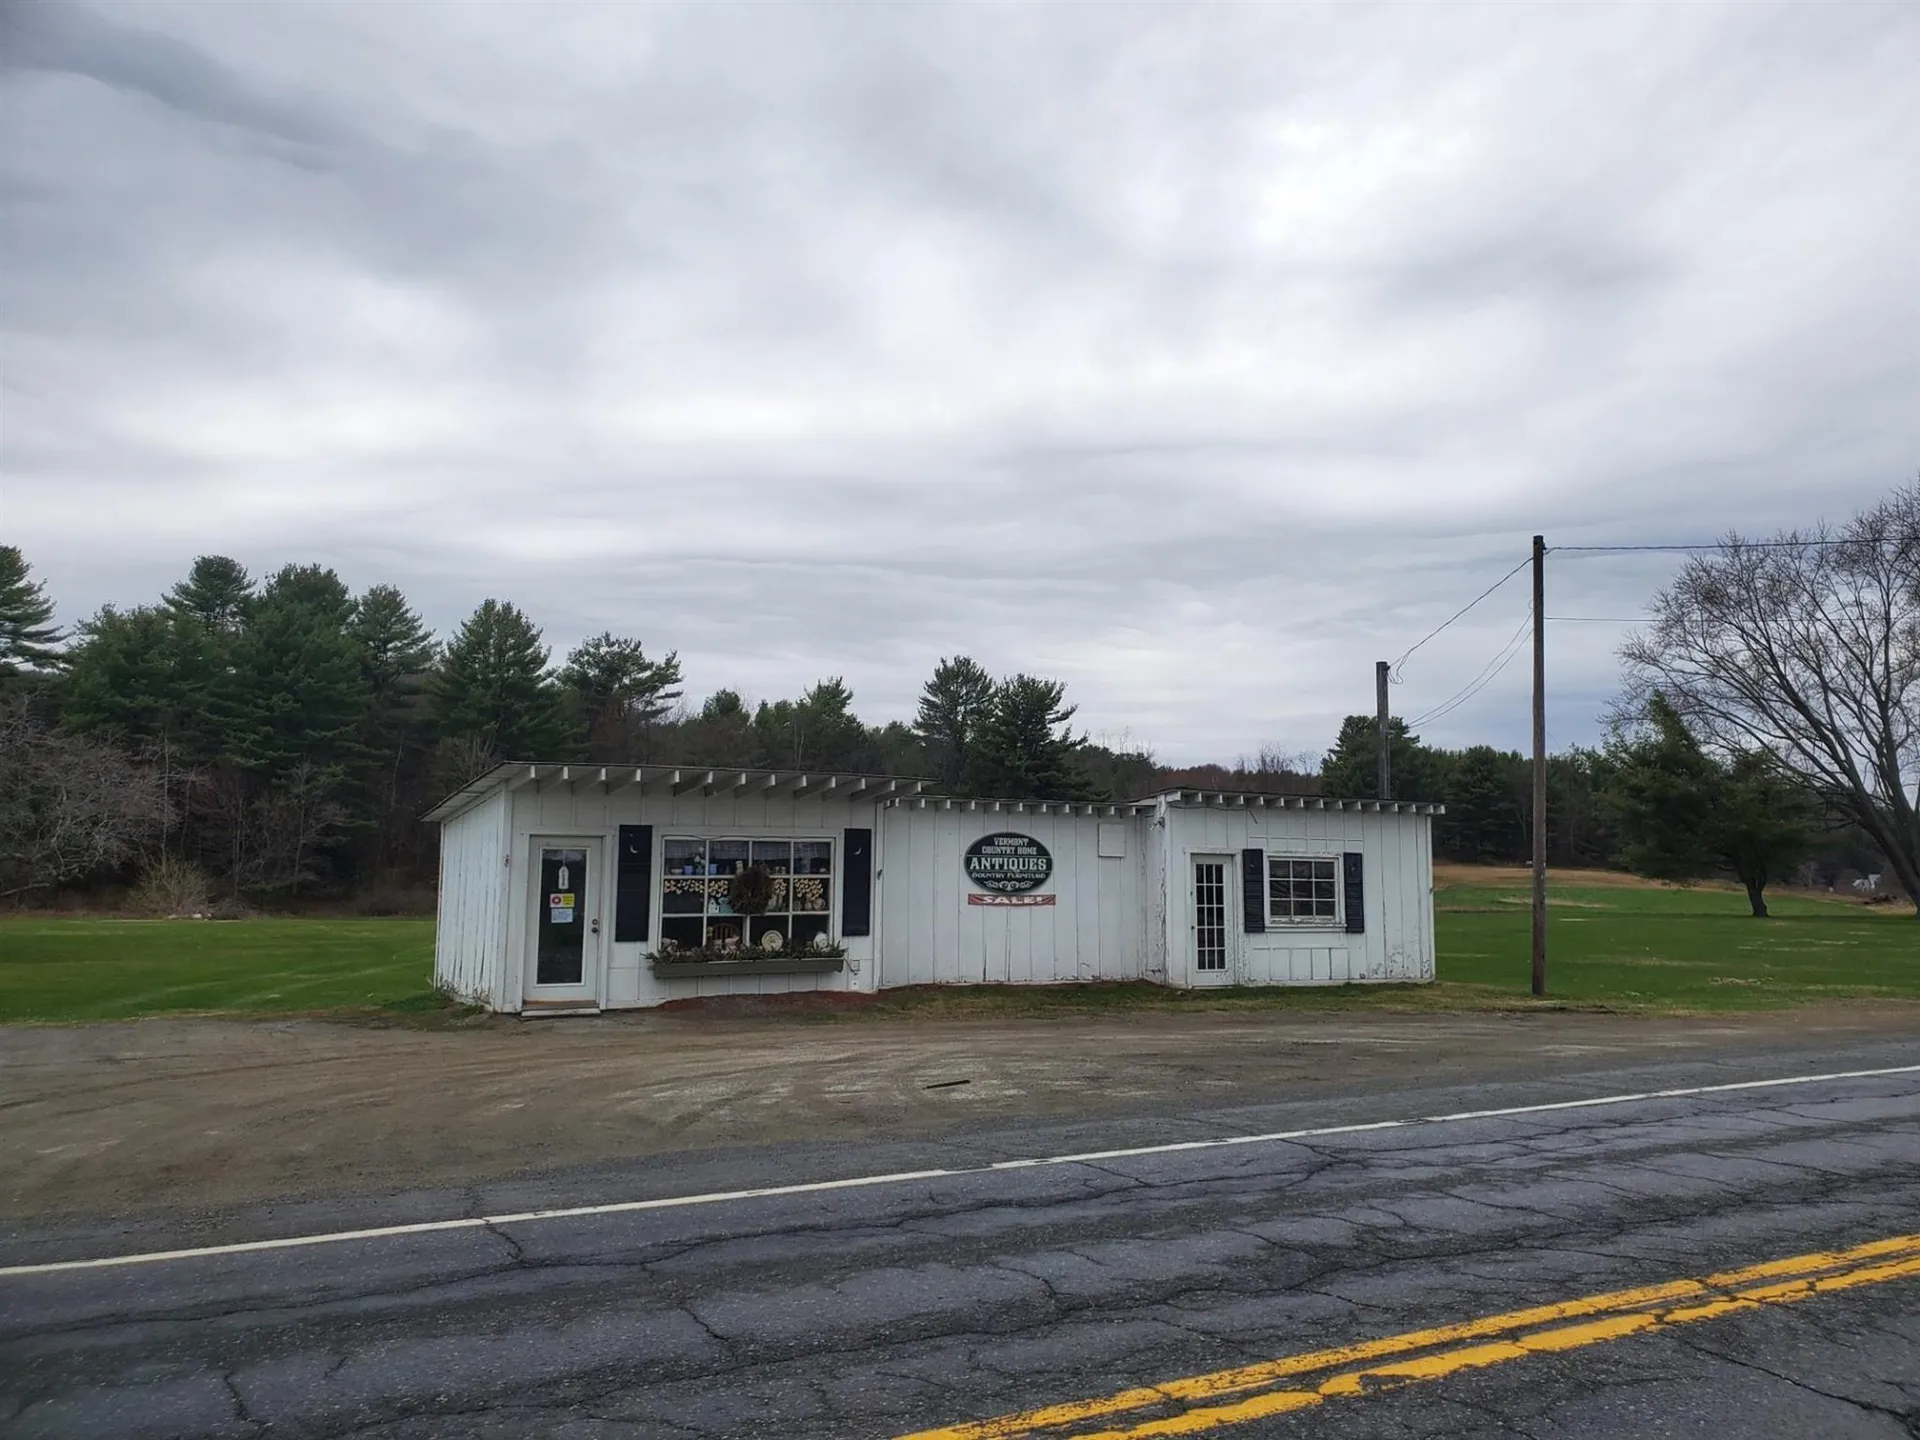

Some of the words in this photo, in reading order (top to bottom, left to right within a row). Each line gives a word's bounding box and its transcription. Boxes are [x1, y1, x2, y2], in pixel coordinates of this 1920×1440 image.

[994, 837, 1029, 846] VERMONT
[982, 846, 1015, 854] COUNTRY
[1017, 846, 1037, 854] HOME
[970, 857, 1047, 871] ANTIQUES
[981, 896, 1043, 904] SALE!
